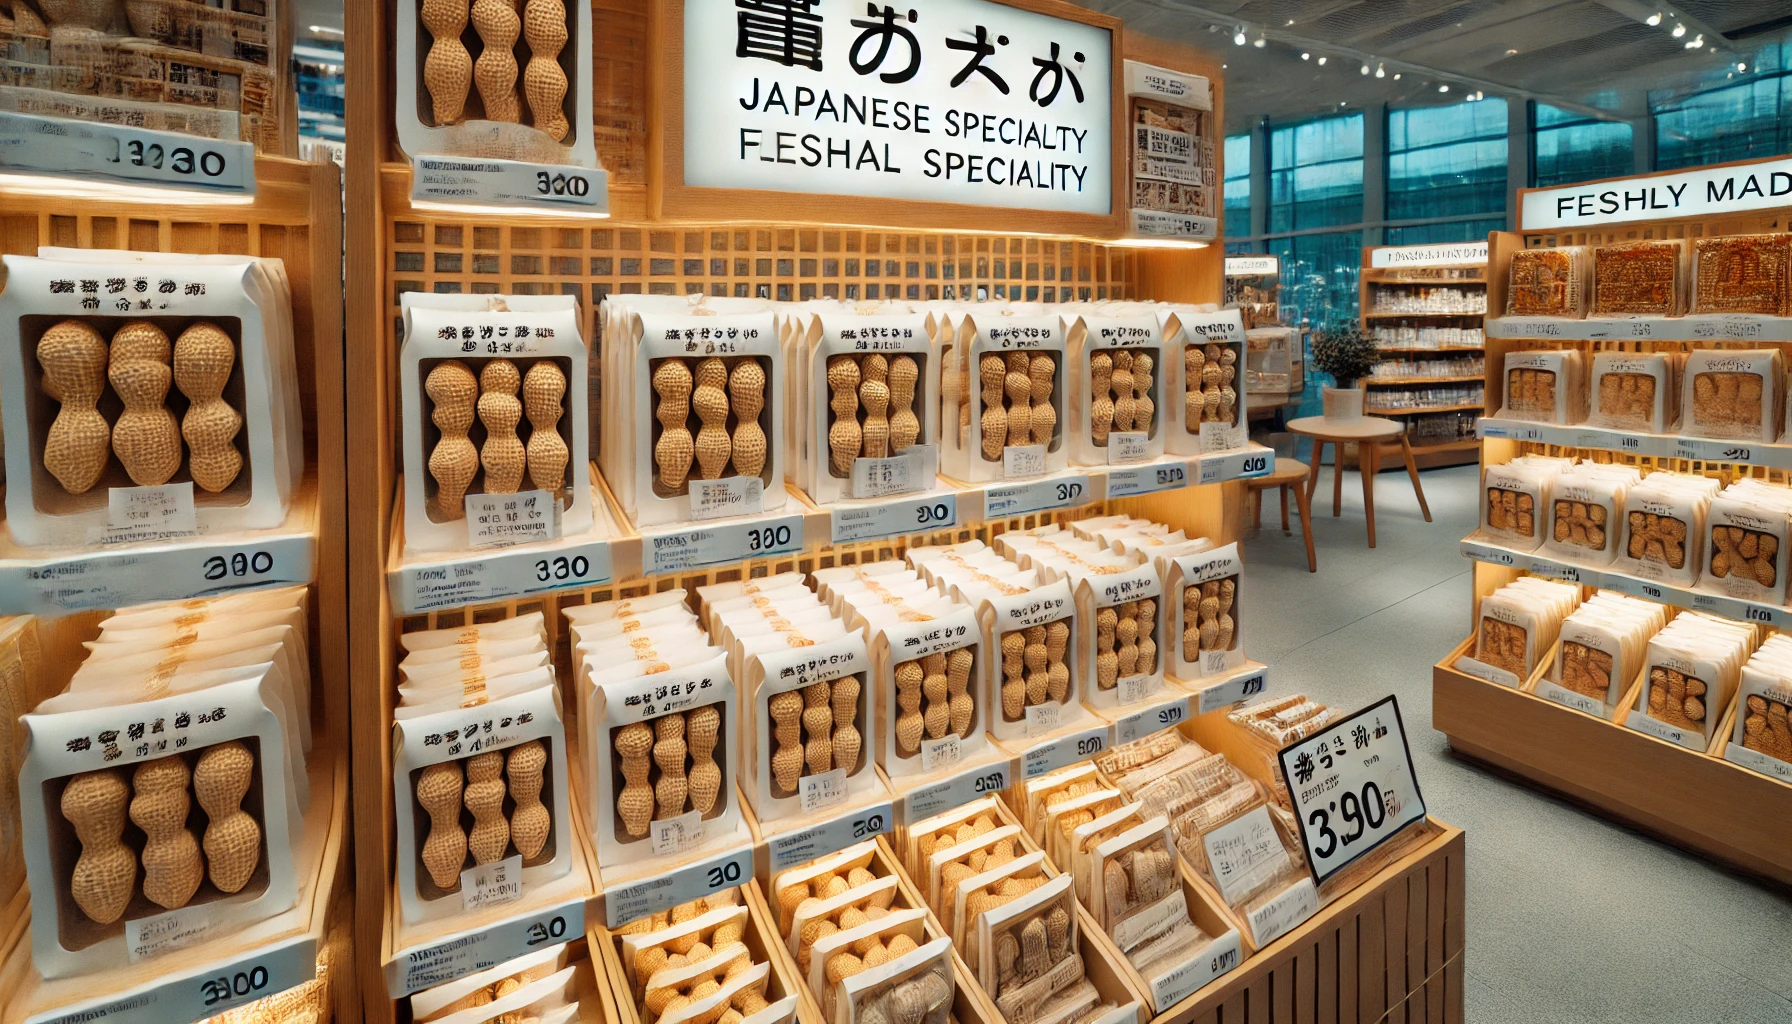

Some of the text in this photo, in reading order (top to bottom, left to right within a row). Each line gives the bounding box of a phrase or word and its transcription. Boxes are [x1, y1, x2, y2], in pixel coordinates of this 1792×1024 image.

[739, 77, 1088, 154] JAPANESE SPECIALTY
[923, 148, 1088, 193] SPECIALITY
[1556, 182, 1688, 219] FESHLY
